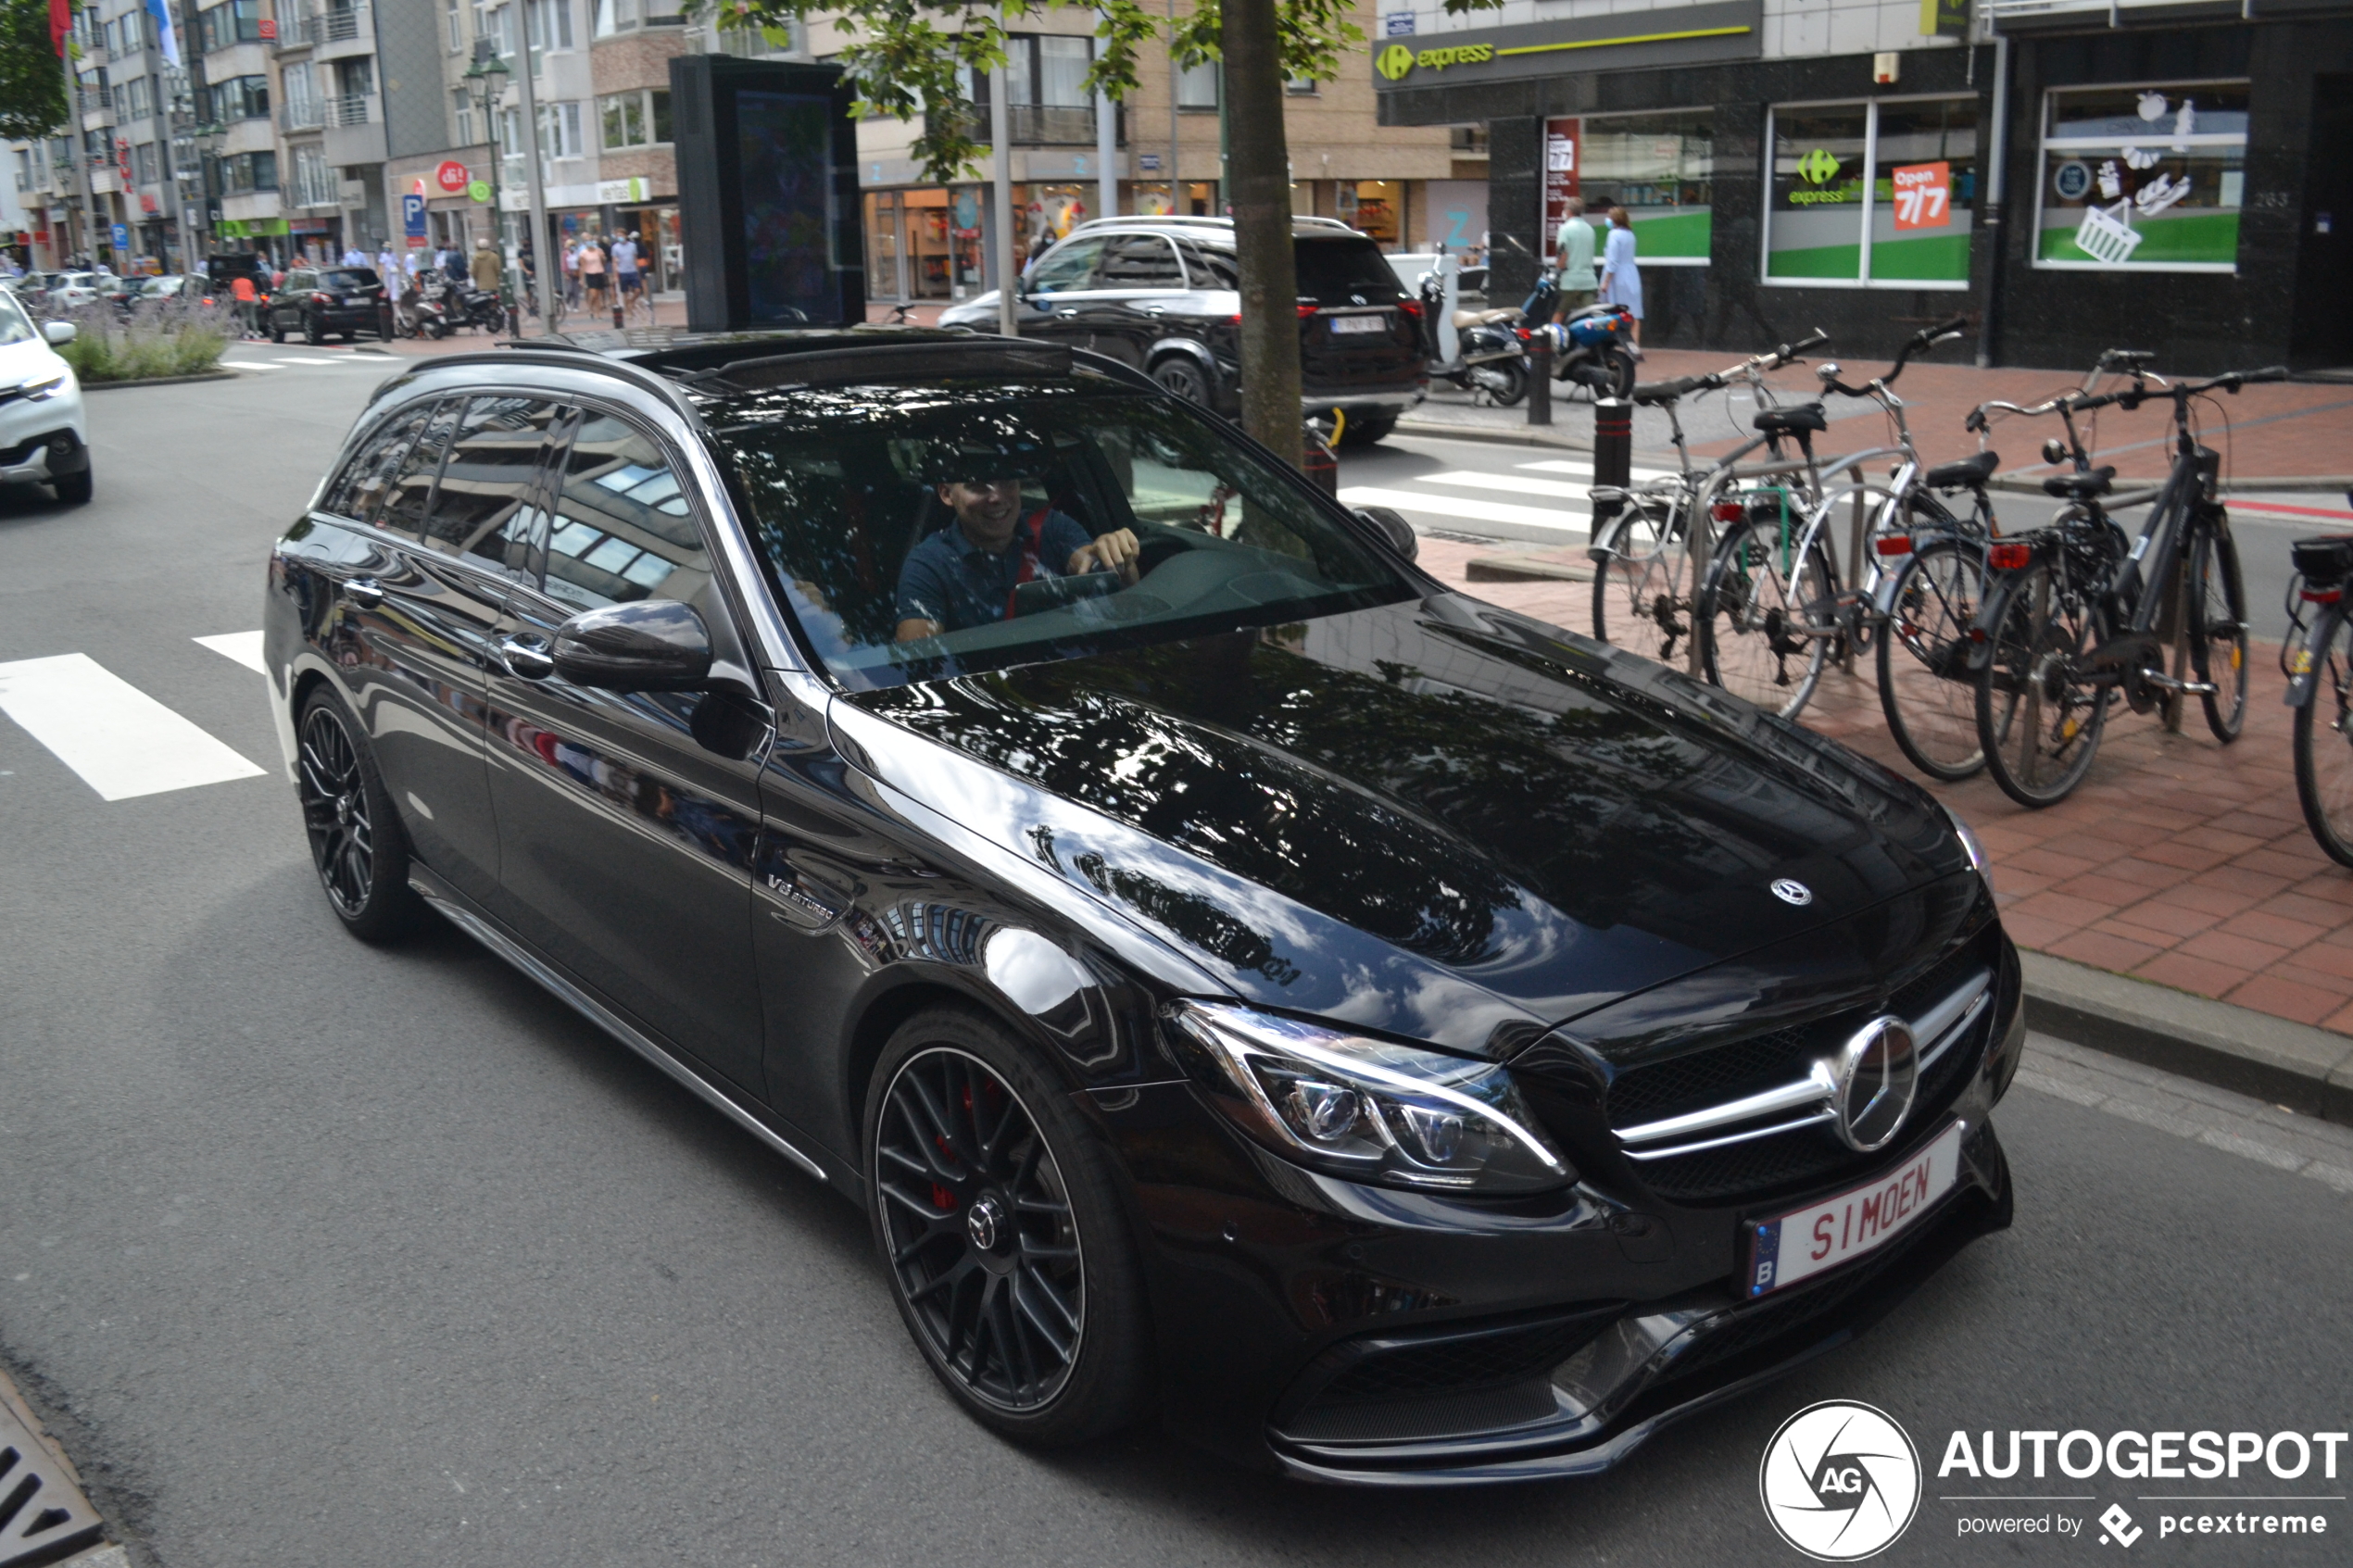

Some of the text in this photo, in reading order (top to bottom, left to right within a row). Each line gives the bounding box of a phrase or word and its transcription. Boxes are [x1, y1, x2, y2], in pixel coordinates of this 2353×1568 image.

[1416, 43, 1494, 71] express
[1894, 169, 1935, 189] Open
[406, 198, 422, 222] P
[1788, 190, 1844, 206] express
[1894, 184, 1946, 224] 7/7
[114, 226, 127, 241] P
[768, 873, 834, 920] V8 BITURBO
[1810, 1157, 1931, 1261] SIMOEN
[1756, 1261, 1773, 1286] B
